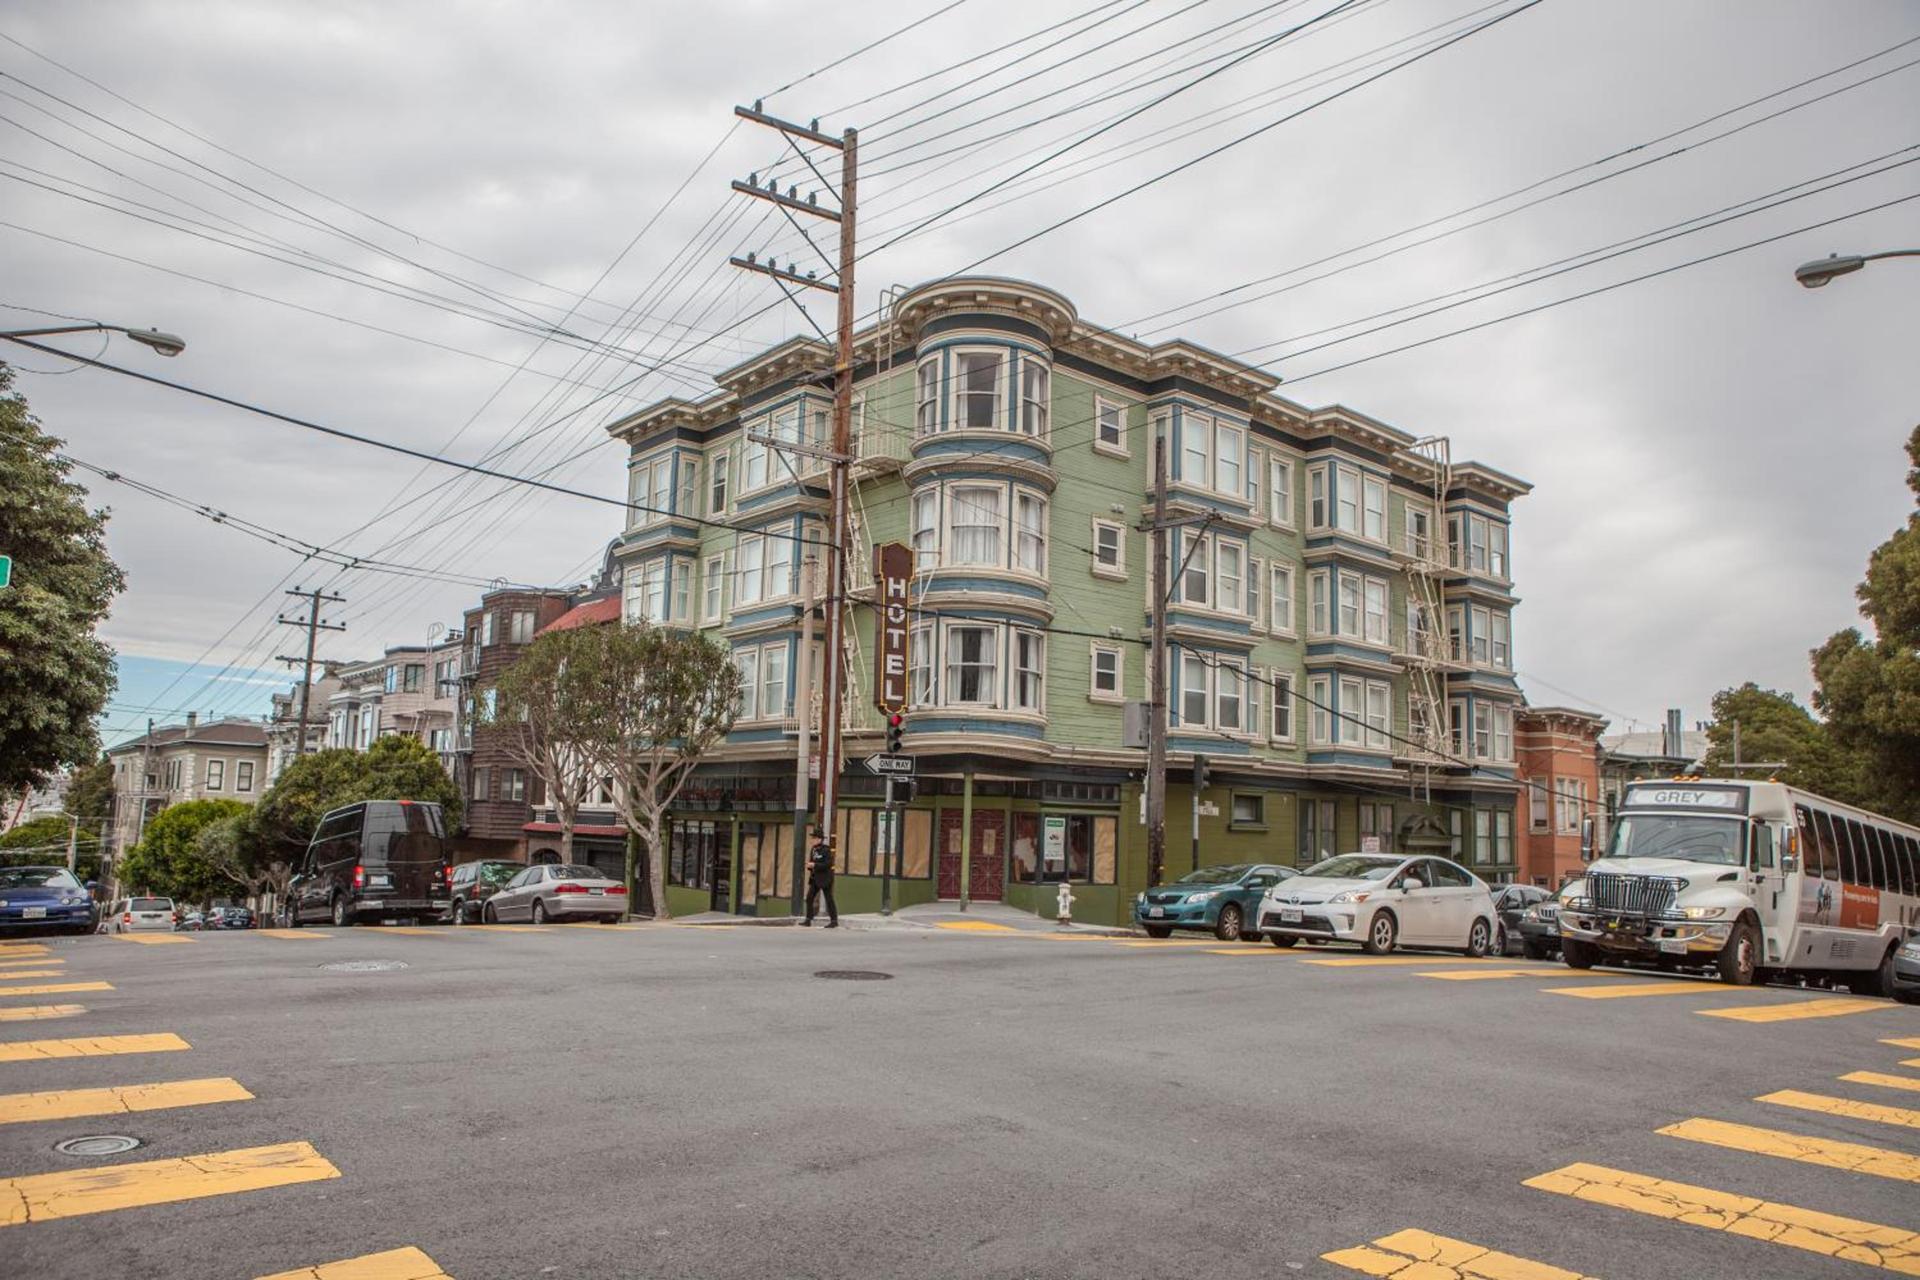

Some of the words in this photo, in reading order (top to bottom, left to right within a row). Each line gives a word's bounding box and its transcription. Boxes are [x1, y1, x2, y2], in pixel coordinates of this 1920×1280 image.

[886, 577, 906, 701] HOTEL
[879, 760, 894, 768] ONE
[895, 761, 909, 769] WAY
[1654, 791, 1705, 804] GREY
